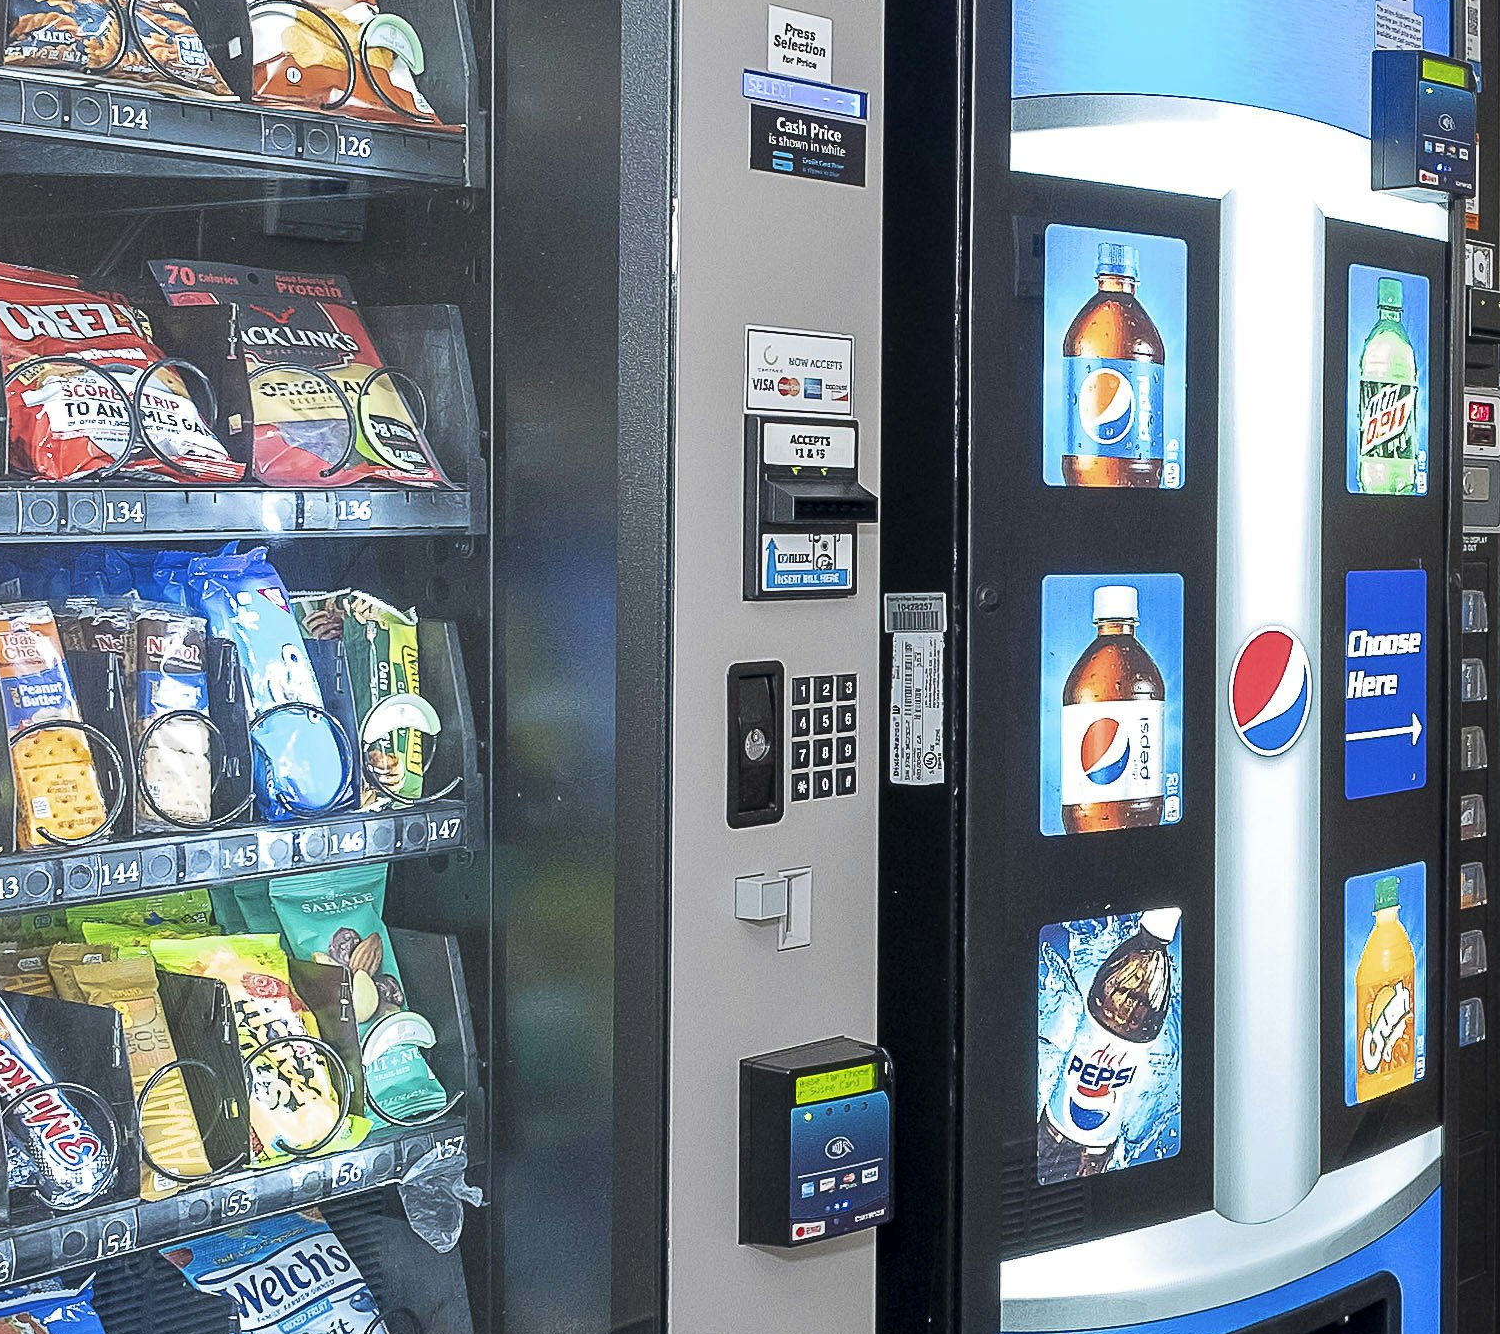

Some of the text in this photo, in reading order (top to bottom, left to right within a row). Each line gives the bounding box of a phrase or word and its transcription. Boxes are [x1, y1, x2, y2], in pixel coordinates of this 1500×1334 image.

[784, 22, 817, 42] Press
[773, 34, 827, 59] Selection
[782, 53, 818, 70] for Price
[748, 77, 795, 99] SELECT
[110, 104, 150, 130] 124
[776, 116, 843, 143] Cash Price
[338, 135, 372, 158] 126
[768, 132, 847, 158] is shown in white
[164, 264, 196, 286] 70
[275, 281, 343, 299] protein
[788, 357, 843, 371] NOW ACCEPTS
[750, 377, 775, 392] VISA
[64, 401, 90, 418] TO
[142, 392, 180, 412] TRIP
[789, 434, 831, 447] ACCEPTS
[806, 448, 814, 460] &
[106, 501, 144, 524] 134
[338, 500, 372, 521] 136
[773, 572, 840, 586] INSERT BILL HERE
[1347, 629, 1422, 658] Choose
[18, 680, 65, 697] Peanut
[799, 680, 854, 698] 1 2 3
[1346, 670, 1399, 700] Here
[21, 694, 63, 709] Butter
[798, 712, 853, 730] 4 5 6
[798, 743, 852, 763] 7 8 9
[1139, 717, 1151, 780] pepsi
[821, 777, 830, 792] 0
[428, 817, 461, 842] 147
[329, 829, 364, 855] 146
[222, 845, 258, 870] 145
[101, 860, 141, 887] 144
[301, 891, 376, 915] SAHALE
[1067, 1055, 1138, 1089] PEPSI
[434, 1136, 465, 1160] 157
[225, 1242, 351, 1319] Welch's
[308, 1302, 330, 1318] FRUIT
